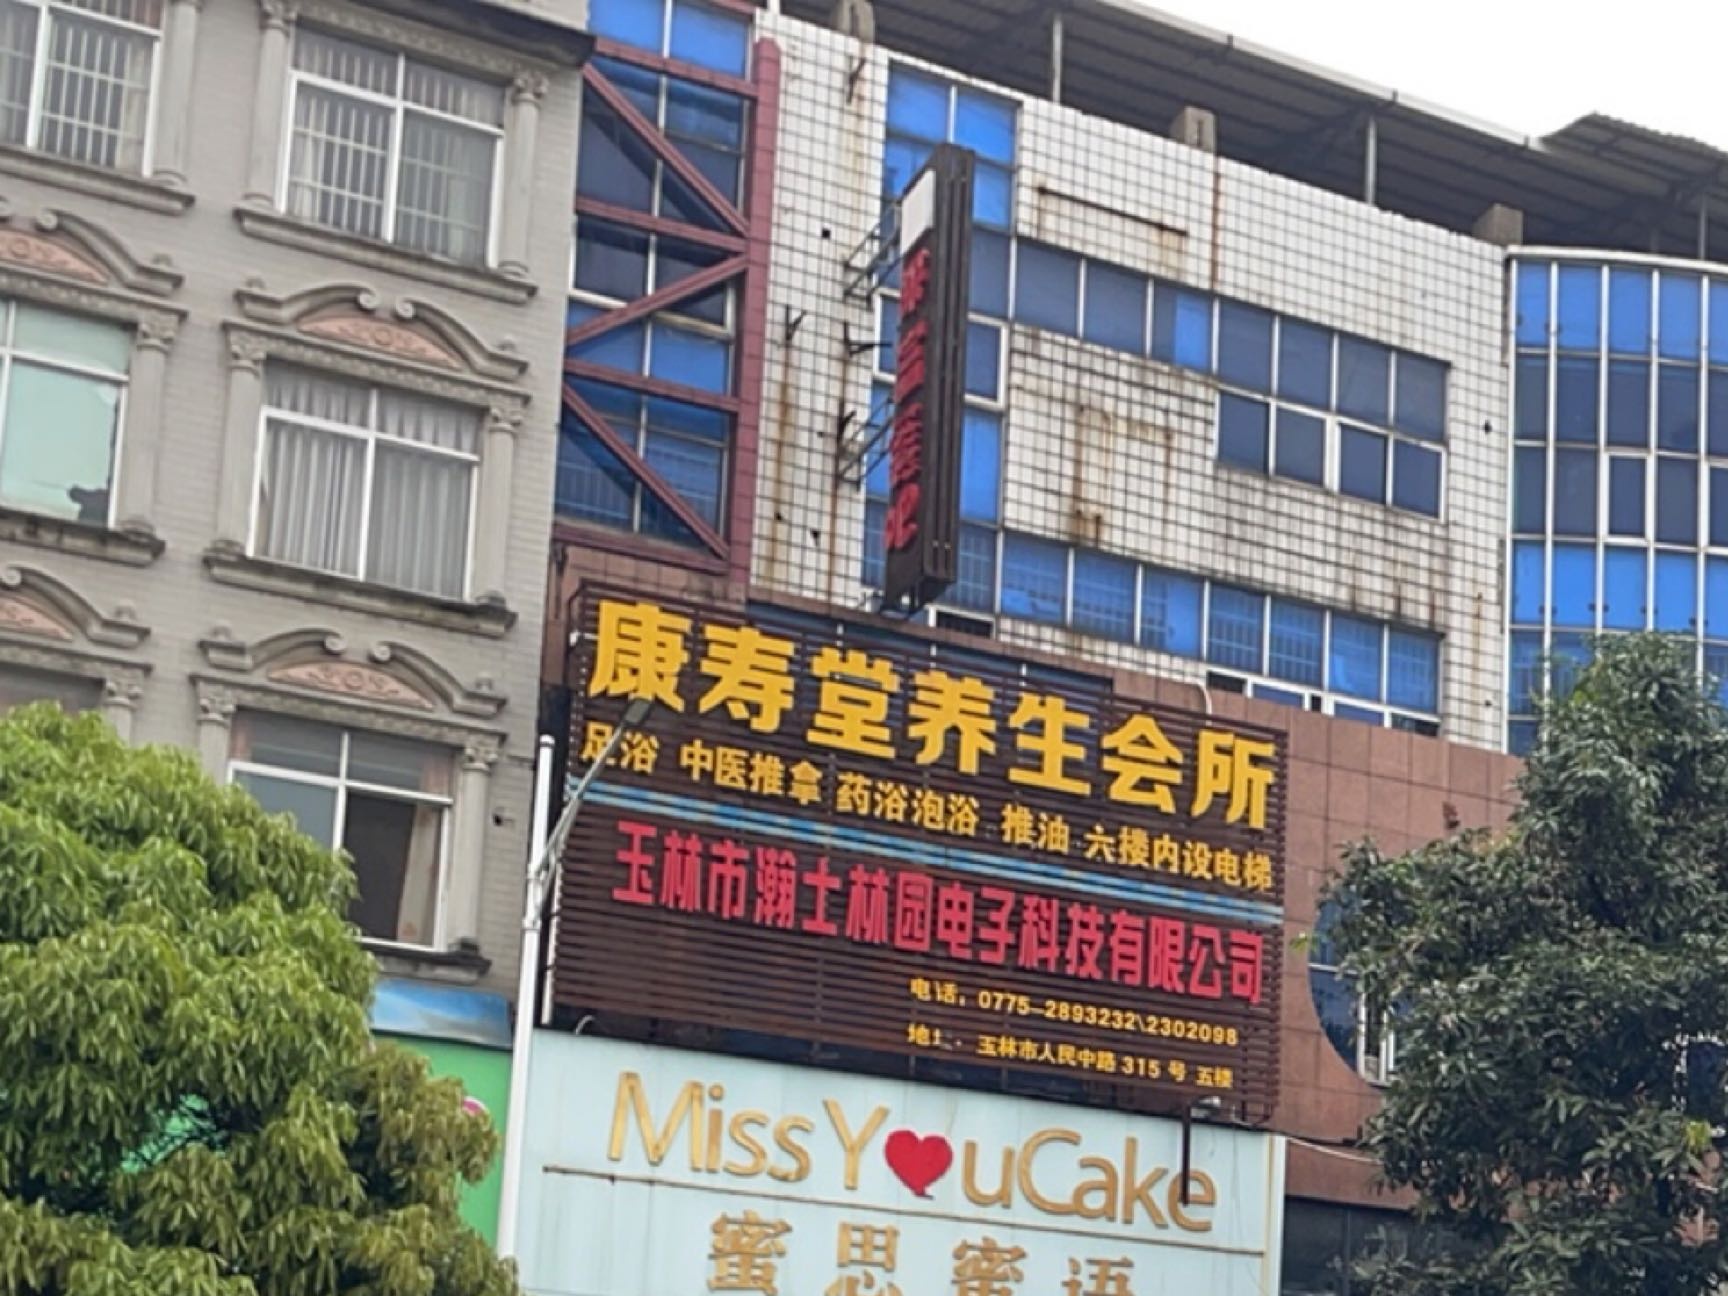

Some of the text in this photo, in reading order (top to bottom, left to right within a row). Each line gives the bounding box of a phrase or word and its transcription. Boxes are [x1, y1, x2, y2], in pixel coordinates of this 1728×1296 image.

[578, 720, 660, 775] 足浴
[679, 738, 823, 806] 中医推拿
[836, 771, 980, 837] 药浴泡浴
[1000, 804, 1069, 853] 推油
[587, 599, 1277, 829] 康寿堂养生会所
[613, 820, 1265, 1005] 玉林市瀚士林园电子科技有限公司
[976, 1033, 1118, 1074] 玉林市人民中路
[1121, 1055, 1162, 1079] 315
[1168, 1061, 1188, 1084] 号
[1195, 1066, 1235, 1090] 五楼
